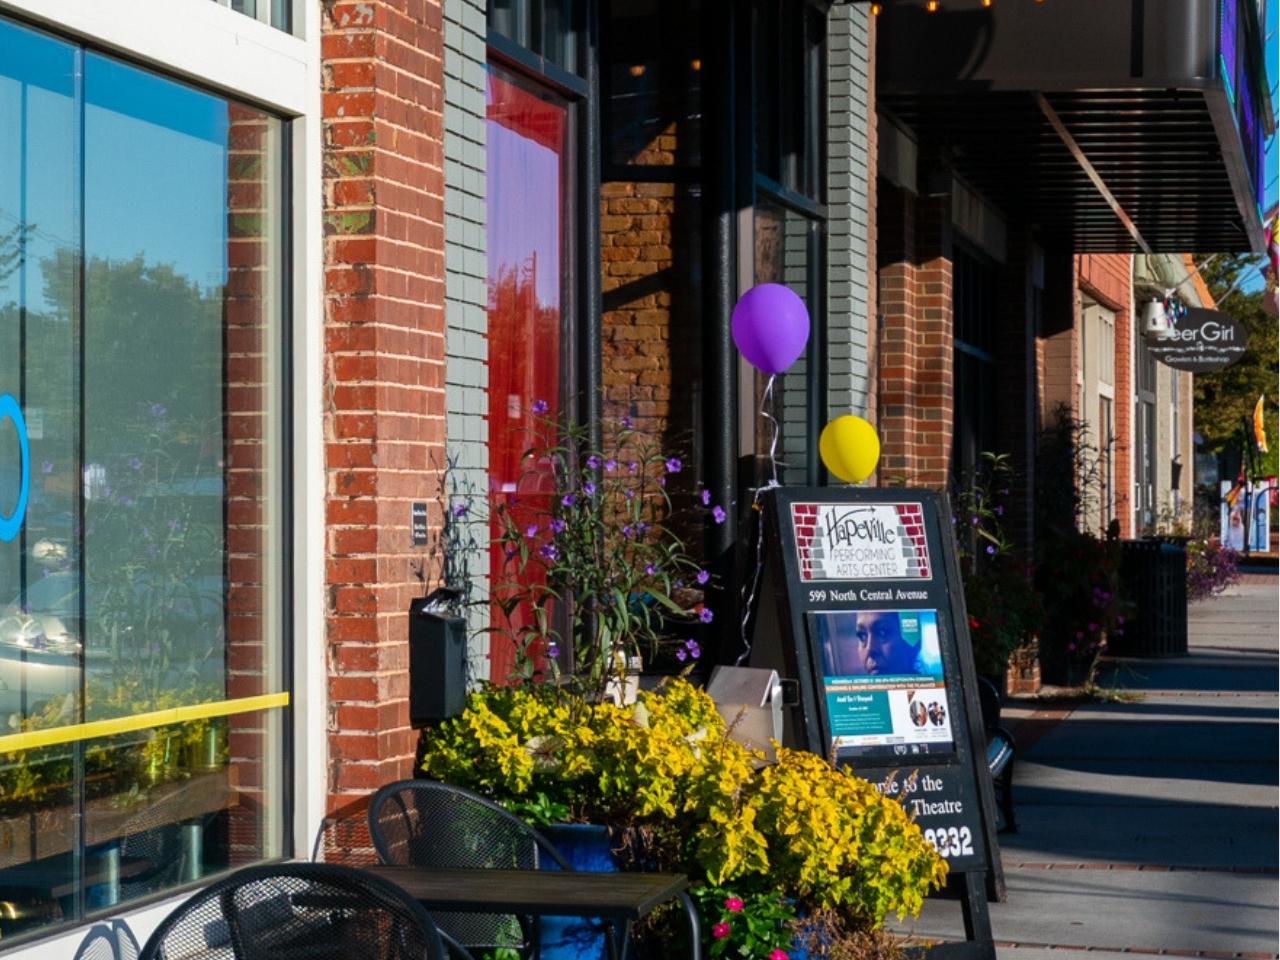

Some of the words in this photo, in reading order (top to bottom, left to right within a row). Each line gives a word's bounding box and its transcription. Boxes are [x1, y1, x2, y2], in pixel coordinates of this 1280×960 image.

[1157, 328, 1199, 341] eer
[1200, 321, 1234, 341] Girl
[825, 505, 895, 552] Hapeville
[832, 547, 896, 561] PERFORMING
[836, 564, 859, 576] ARTS
[862, 563, 898, 576] CENTER
[809, 590, 826, 601] 599
[830, 590, 857, 601] North
[860, 589, 893, 601] Central
[896, 589, 928, 600] Avenue
[922, 774, 944, 792] the
[911, 798, 963, 816] Theatre
